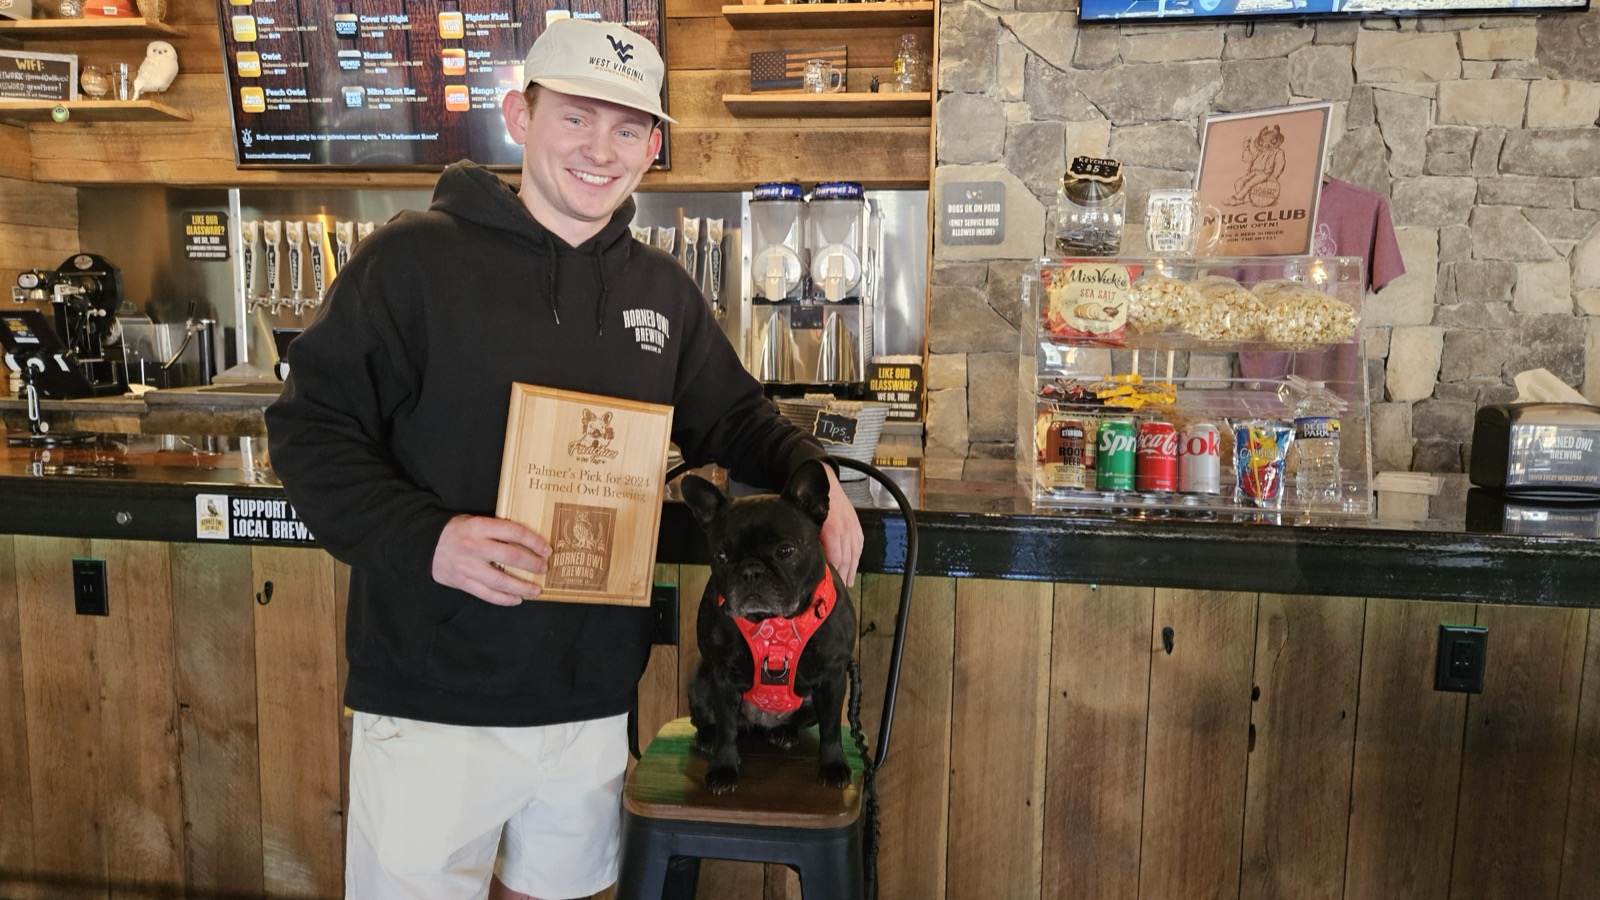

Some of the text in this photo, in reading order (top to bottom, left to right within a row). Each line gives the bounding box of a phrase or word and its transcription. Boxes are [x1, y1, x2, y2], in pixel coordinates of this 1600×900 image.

[389, 15, 408, 24] Night
[465, 14, 490, 22] Fighter
[573, 11, 601, 19] Screech
[468, 51, 491, 59] Raptor
[15, 58, 45, 71] WIFI:
[589, 56, 610, 68] WEST
[404, 88, 416, 96] Ear
[471, 87, 494, 95] Mango
[296, 134, 310, 142] party
[1078, 156, 1118, 167] KEYCHAINS
[948, 203, 1000, 213] DOGS OK ON PATIO
[192, 215, 218, 225] LIKE OUR
[948, 218, 999, 227] (ONLY SERVICE DOGS
[1203, 208, 1306, 227] MUG CLUB
[186, 225, 225, 235] GLASSWARE?
[952, 228, 996, 236] ALLOWED INSIDE)
[1069, 269, 1096, 282] Miss
[1080, 288, 1117, 300] SEA SALT
[622, 309, 670, 339] HORNED OWL
[635, 327, 664, 348] BREWING
[878, 368, 910, 379] LIKE OUR
[870, 380, 918, 392] GLASSWARE?
[877, 392, 910, 402] WE DO, TOO!
[1304, 422, 1328, 430] DEER
[1304, 430, 1330, 438] PARK
[1576, 437, 1594, 452] OWL
[1058, 447, 1085, 457] ROOT
[1550, 450, 1582, 460] BREWING
[590, 456, 602, 465] Tap
[1063, 457, 1080, 466] BEER
[528, 463, 650, 487] Palmer's Pick for 2024
[528, 478, 646, 503] Horned Owl Brewing
[232, 498, 287, 519] SUPPORT
[233, 518, 270, 538] LOCAL
[554, 552, 604, 570] HORNED OWL
[561, 566, 594, 580] BREWING
